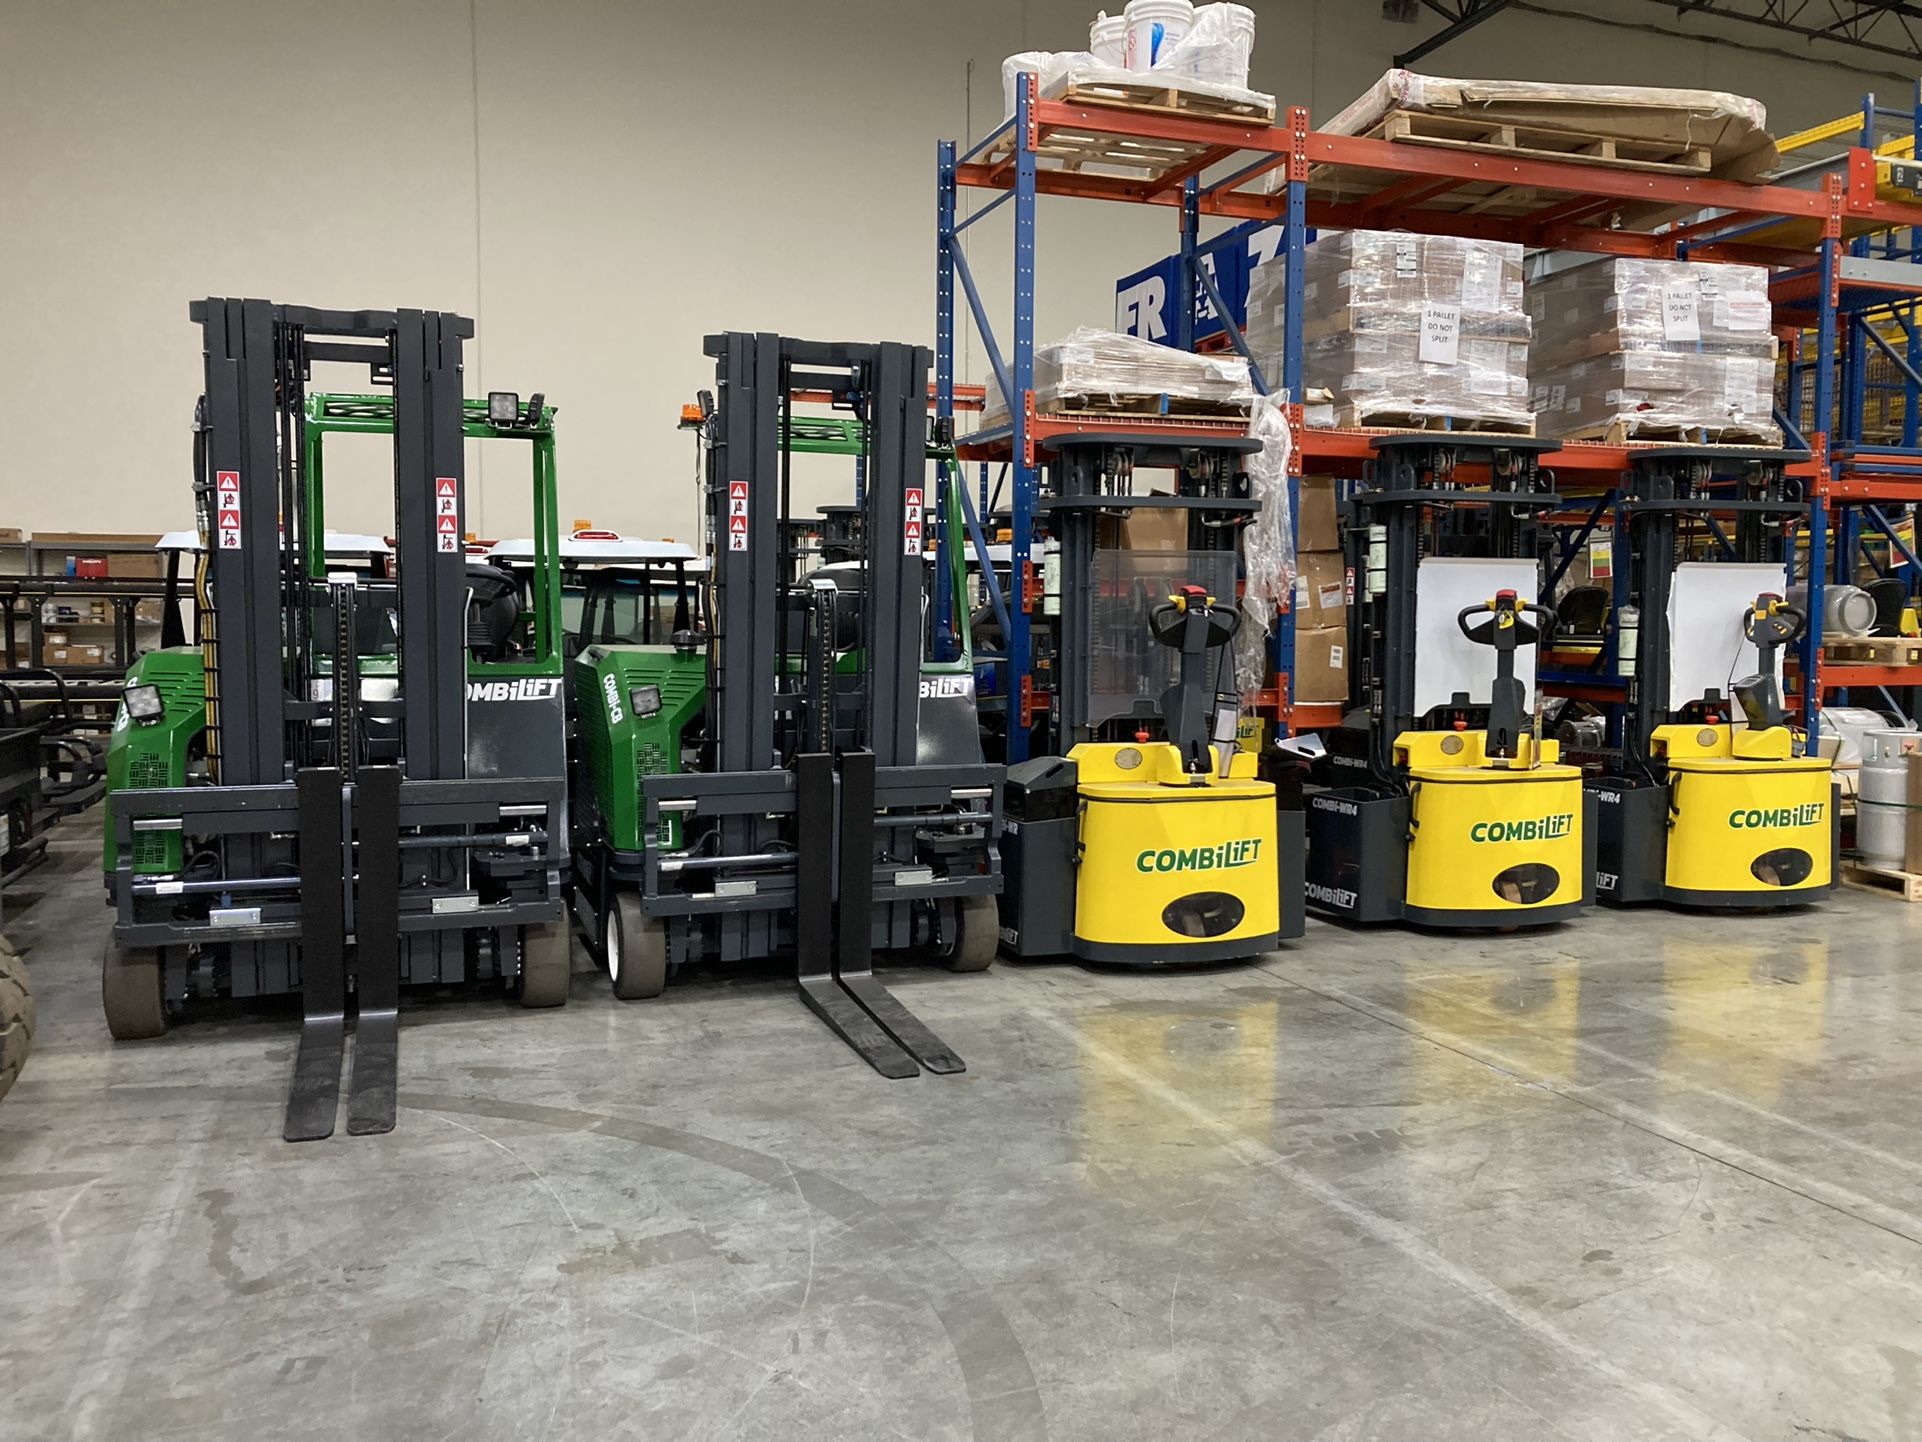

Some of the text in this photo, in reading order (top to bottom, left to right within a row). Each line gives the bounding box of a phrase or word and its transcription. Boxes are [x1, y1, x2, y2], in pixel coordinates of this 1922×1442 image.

[1432, 311, 1455, 320] PALLET
[1427, 322, 1453, 332] DO NOT
[1431, 335, 1448, 343] SPLIT
